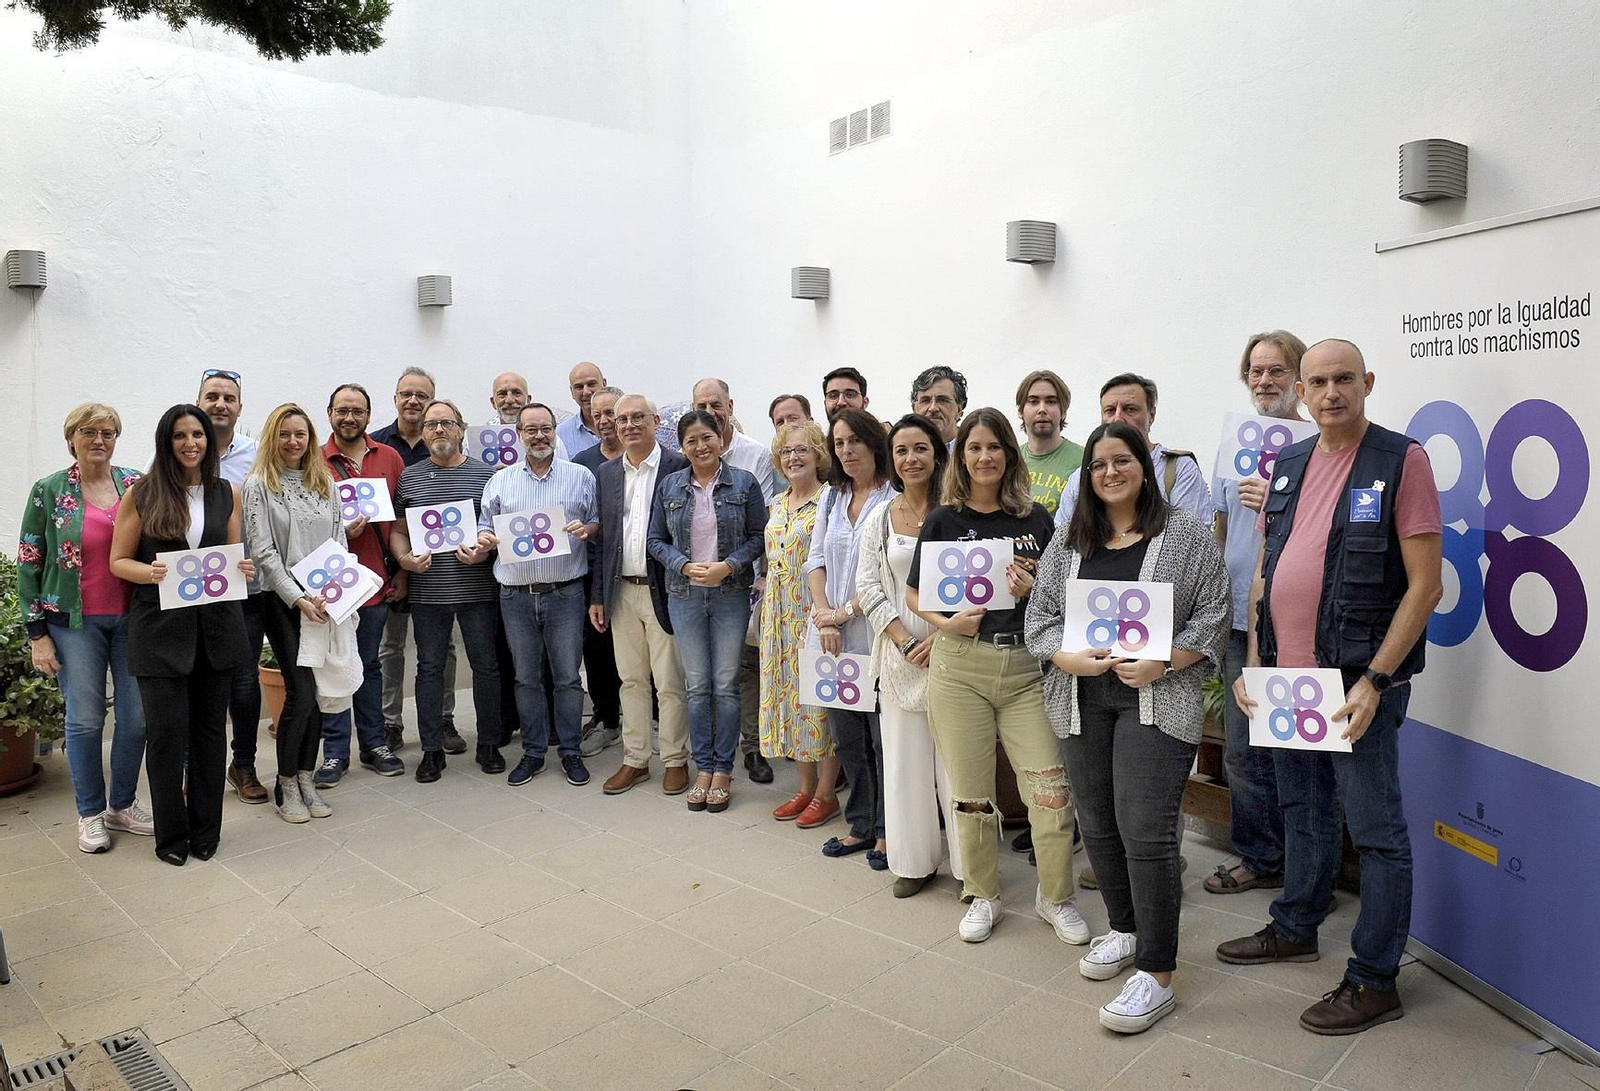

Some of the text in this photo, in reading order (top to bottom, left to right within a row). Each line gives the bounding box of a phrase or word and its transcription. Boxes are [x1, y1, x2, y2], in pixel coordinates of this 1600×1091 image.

[1402, 292, 1591, 334] Hombres por la Igualdad
[1410, 328, 1581, 359] contra los machismos
